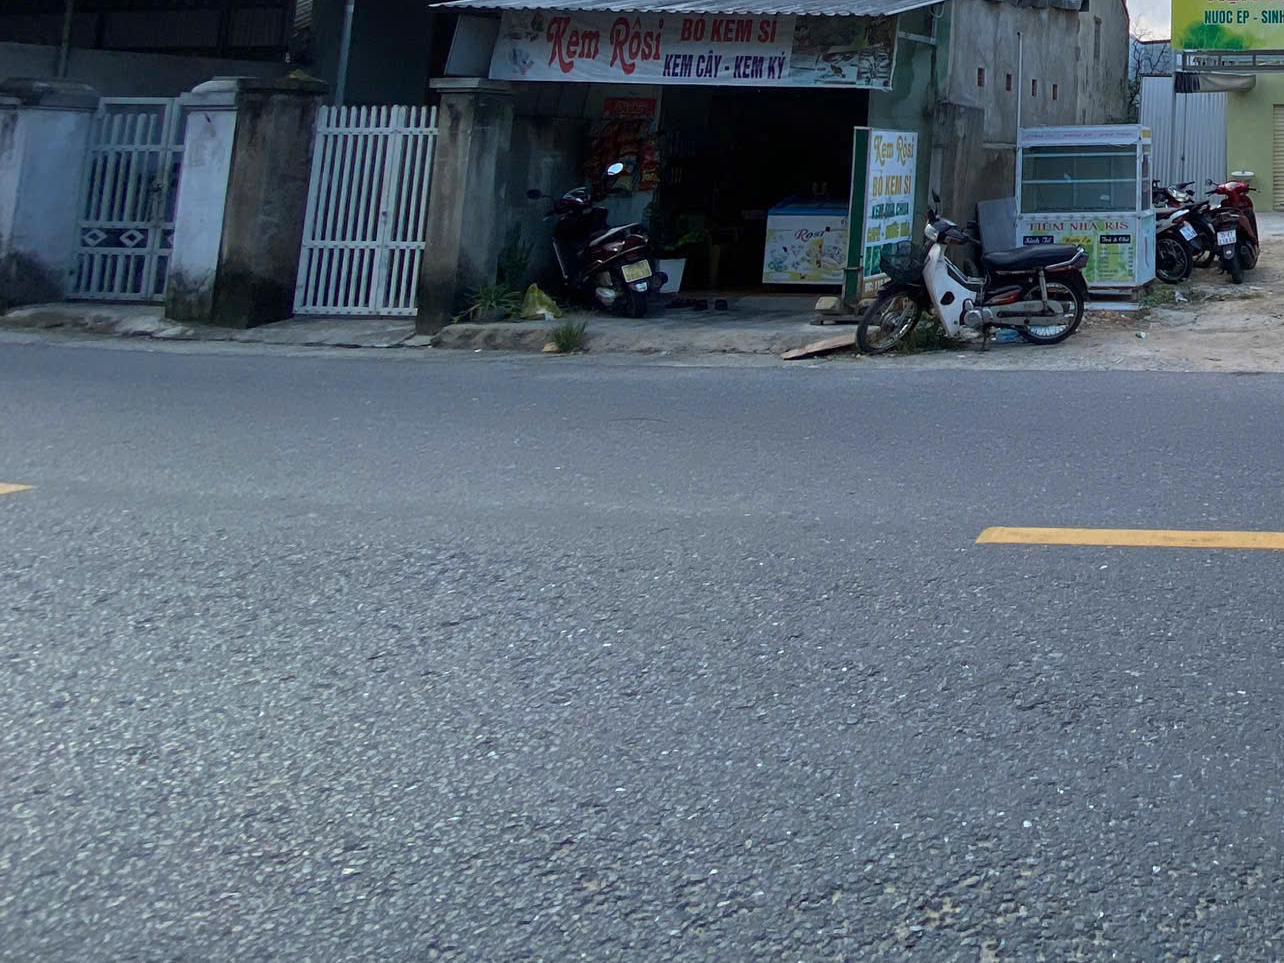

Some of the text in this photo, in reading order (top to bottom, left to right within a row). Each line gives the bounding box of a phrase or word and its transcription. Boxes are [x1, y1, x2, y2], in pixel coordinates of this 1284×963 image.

[710, 19, 753, 43] KEM
[547, 16, 664, 75] Kem Rôsi
[662, 53, 694, 78] KEM
[695, 49, 722, 78] CÂY
[733, 55, 765, 79] KEM
[767, 51, 786, 79] KÝ
[874, 135, 894, 166] Kem
[885, 174, 903, 196] KEM
[1105, 221, 1129, 230] RIS
